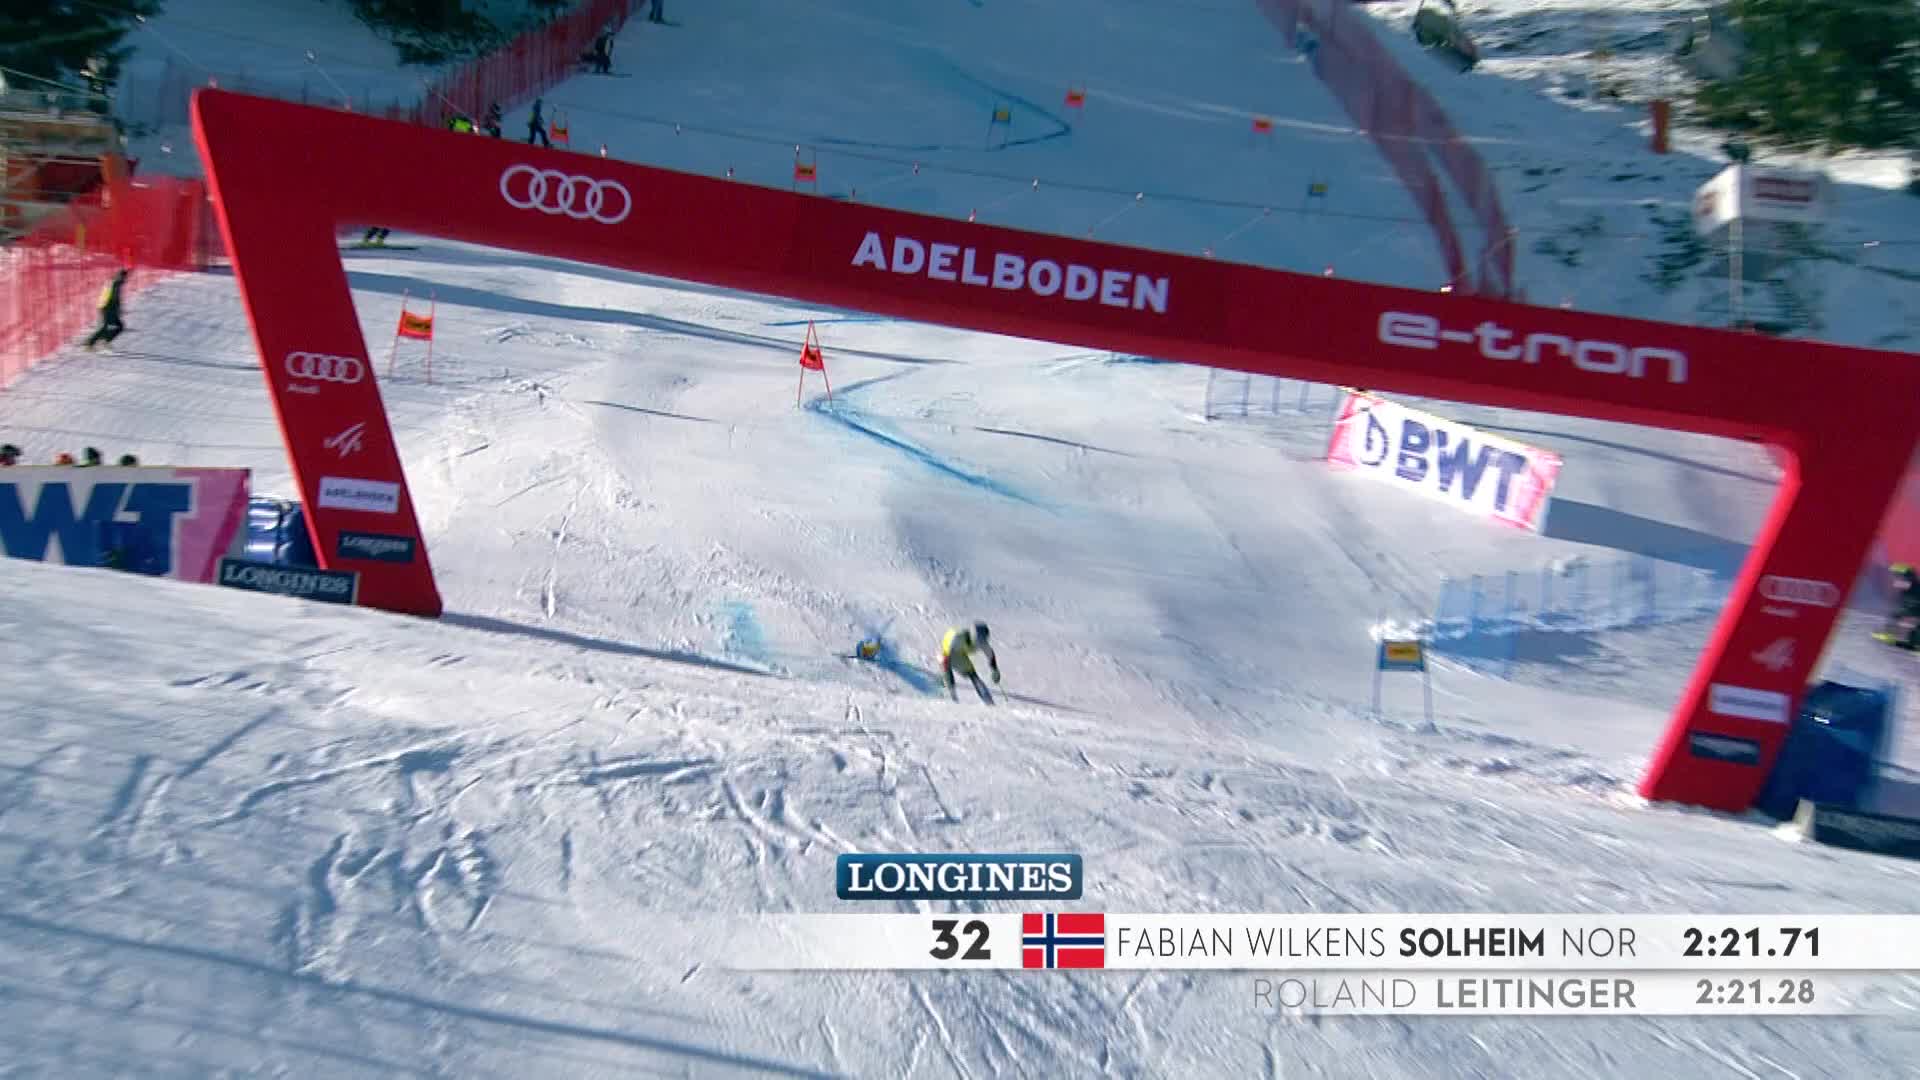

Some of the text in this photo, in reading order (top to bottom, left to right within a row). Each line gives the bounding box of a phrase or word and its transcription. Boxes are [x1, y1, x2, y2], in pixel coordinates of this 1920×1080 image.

[852, 231, 1170, 315] ADELBODEN
[1378, 311, 1688, 384] e-tron
[1395, 418, 1528, 512] BWT
[224, 564, 349, 594] LONGINES
